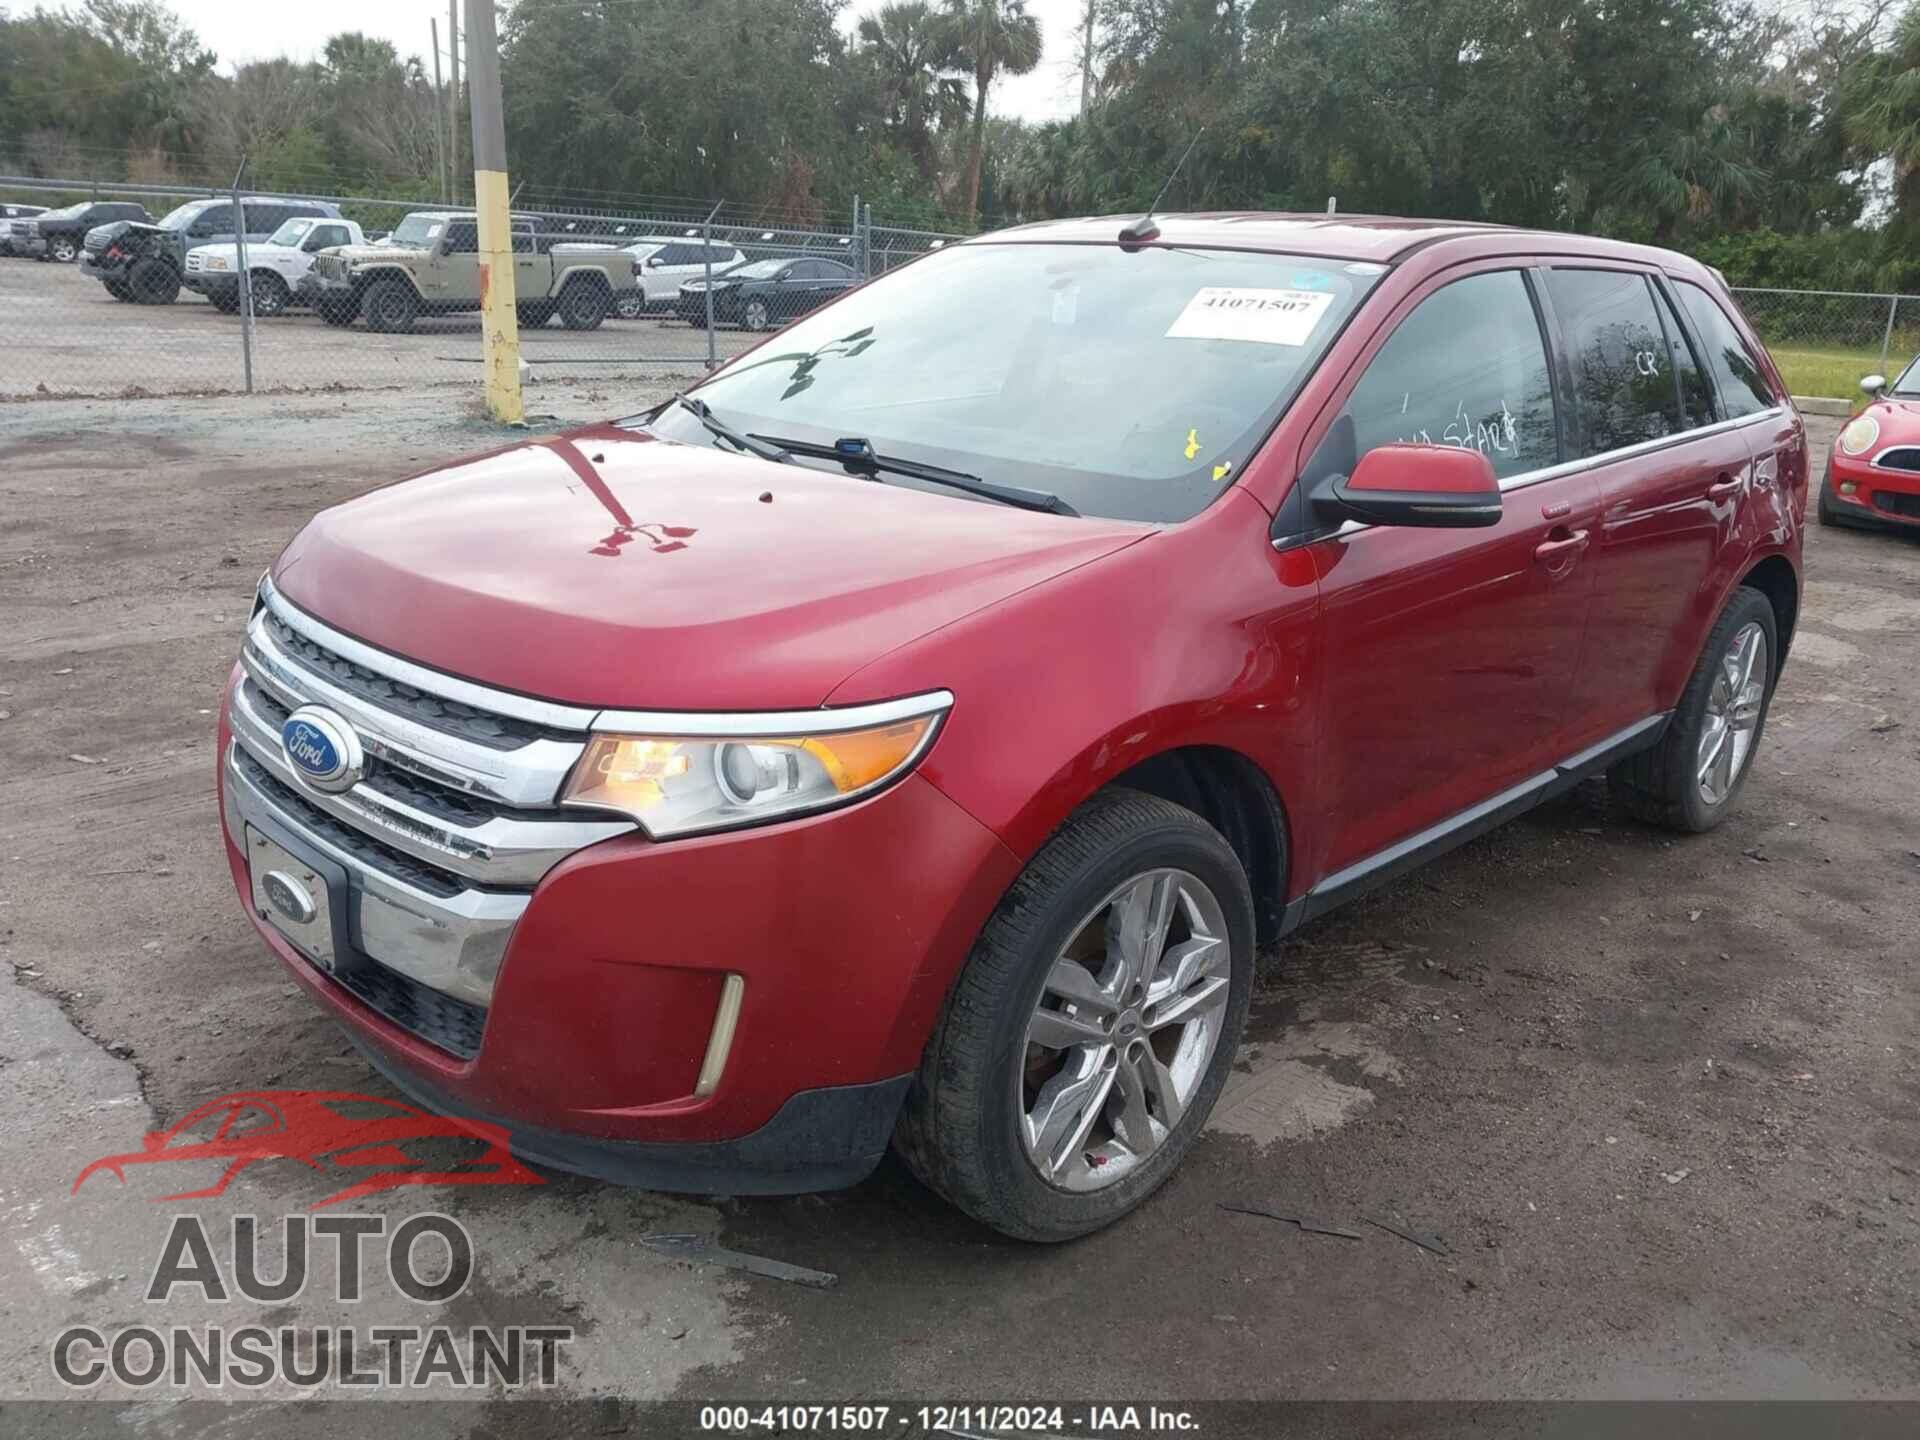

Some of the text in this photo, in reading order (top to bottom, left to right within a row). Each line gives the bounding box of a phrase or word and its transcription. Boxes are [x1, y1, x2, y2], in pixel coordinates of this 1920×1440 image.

[1202, 298, 1310, 312] 41071507
[1636, 351, 1659, 376] CR
[289, 723, 326, 766] Ford
